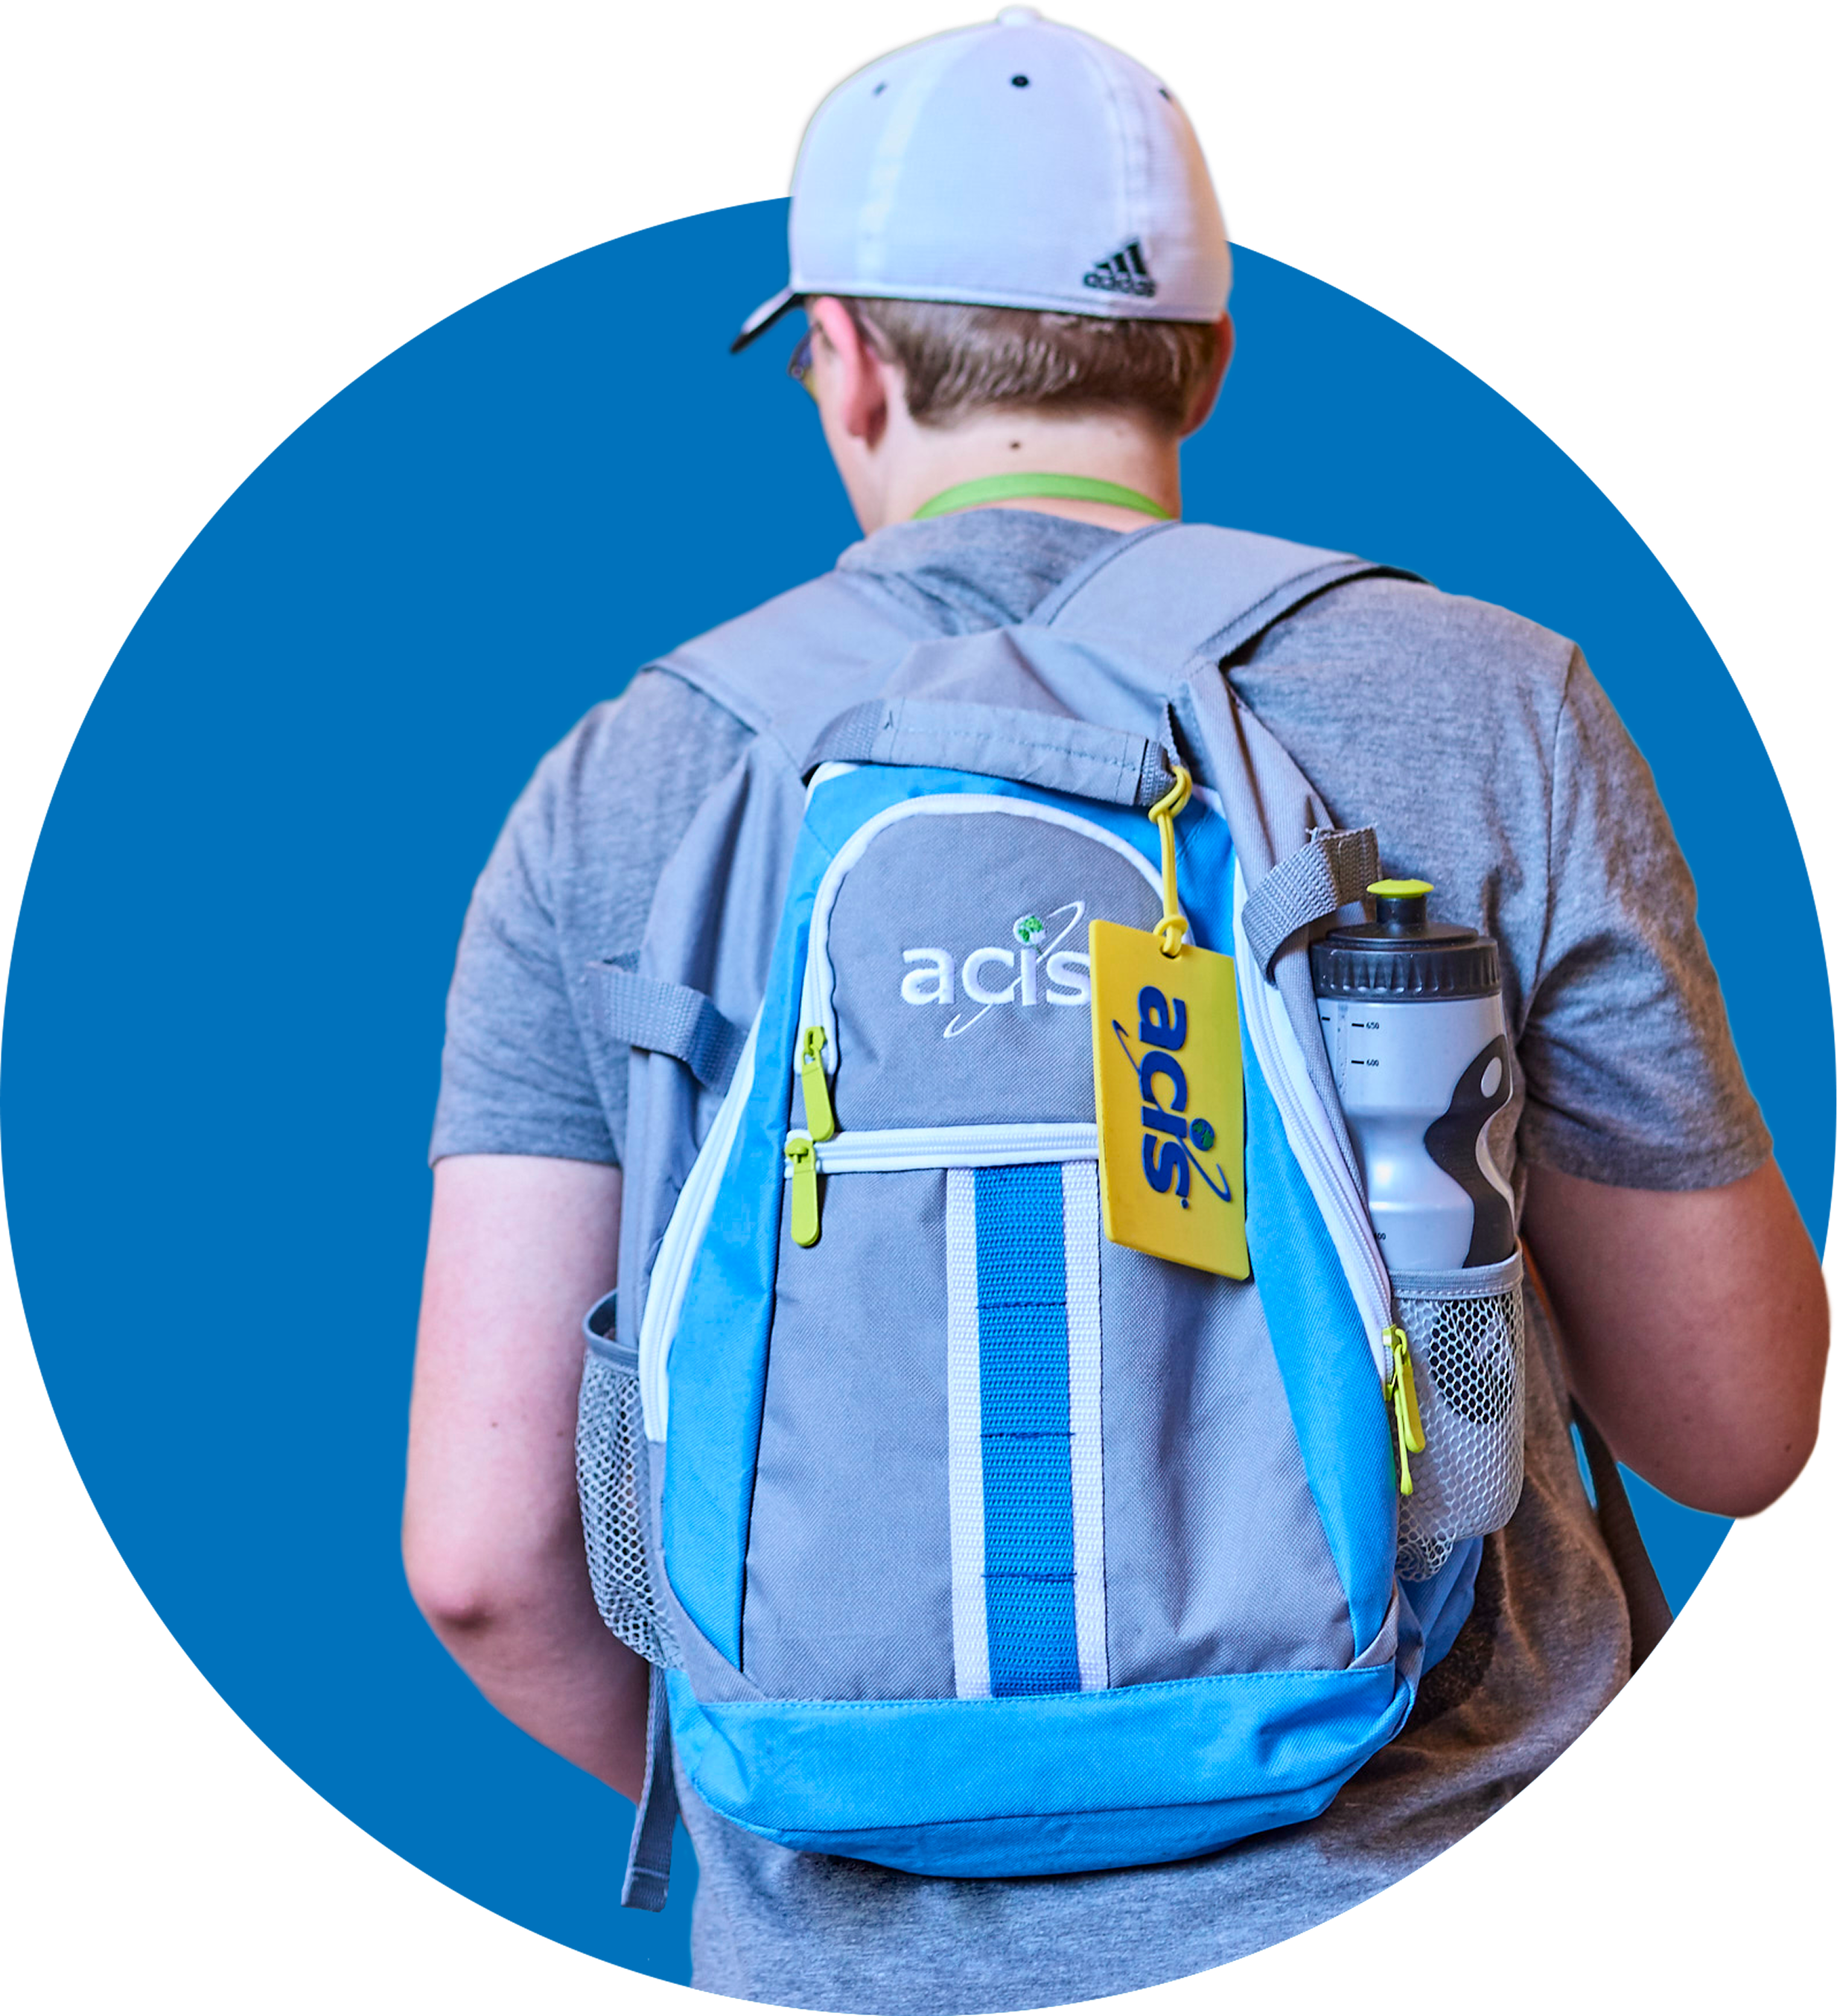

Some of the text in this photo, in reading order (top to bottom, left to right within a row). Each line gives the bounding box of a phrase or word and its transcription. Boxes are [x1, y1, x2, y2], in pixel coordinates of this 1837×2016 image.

[1083, 269, 1156, 298] adidas
[900, 915, 1091, 1007] acis
[1366, 1021, 1380, 1030] 650
[1366, 1059, 1380, 1067] 600
[1138, 985, 1215, 1199] acis
